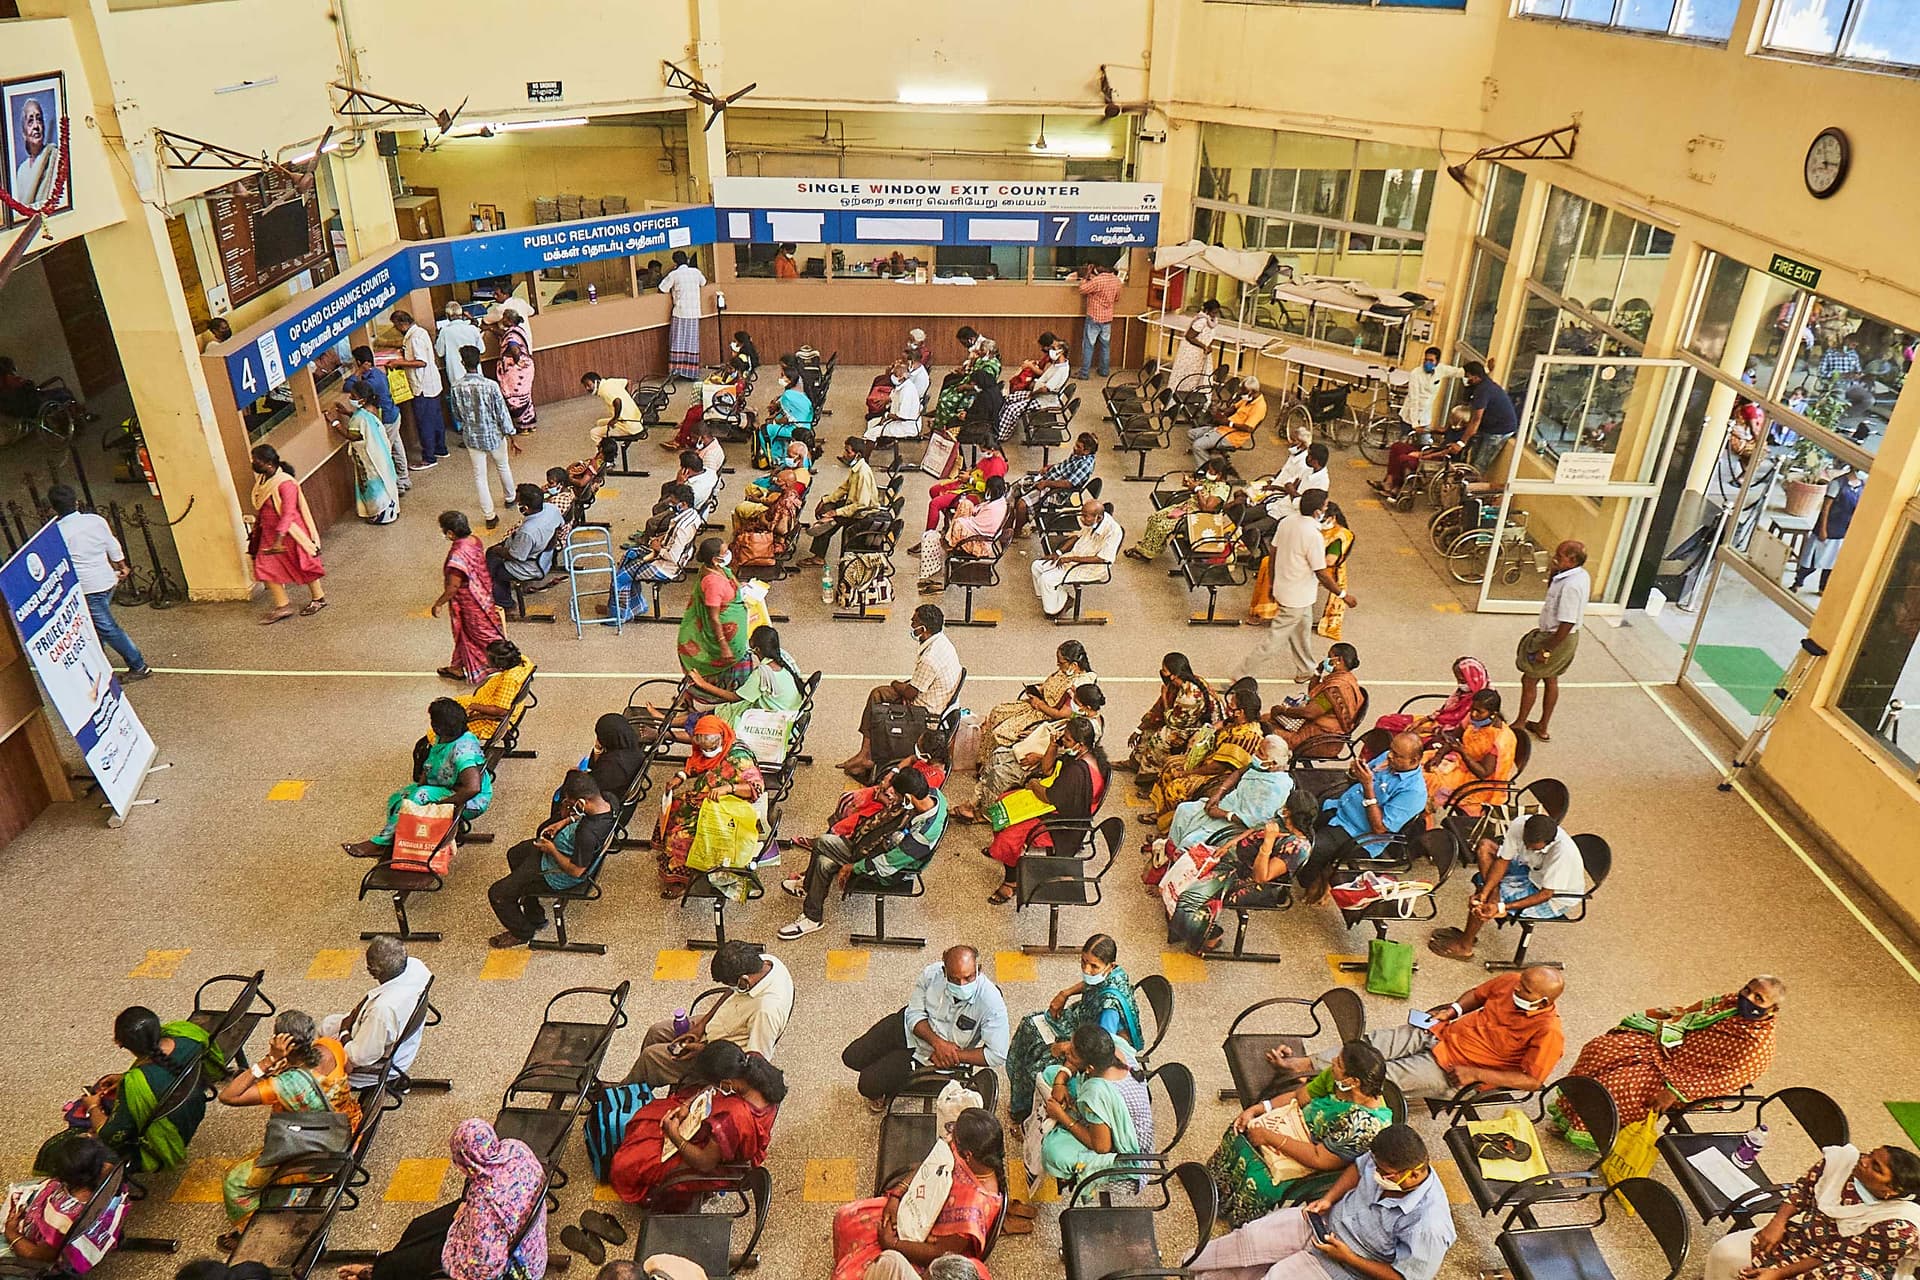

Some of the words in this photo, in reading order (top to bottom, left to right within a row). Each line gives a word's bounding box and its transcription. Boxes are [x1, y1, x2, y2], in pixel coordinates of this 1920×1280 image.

[797, 183, 860, 194] SINGLE
[870, 184, 941, 195] WINDOW
[951, 186, 990, 196] EXIT
[998, 186, 1080, 196] COUNTER
[840, 195, 884, 207] ஒற்றை
[888, 198, 922, 207] சாளர
[926, 196, 998, 208] வெளியேறு
[1002, 196, 1047, 206] மையம்
[1052, 216, 1070, 242] 7
[1088, 214, 1110, 222] CASH
[1112, 214, 1150, 222] COUNTER
[523, 232, 567, 248] PUBLIC
[570, 222, 631, 242] RELATIONS
[632, 216, 679, 232] OFFICER
[543, 245, 580, 262] மக்கள்
[582, 239, 624, 258] தொடர்பு
[626, 232, 666, 250] அதிகாரி
[418, 251, 440, 282] 5
[1774, 258, 1795, 276] FIRE
[1794, 266, 1816, 283] EXIT
[289, 324, 301, 341] OP
[302, 311, 323, 333] CARD
[322, 286, 362, 320] CLEARANCE
[360, 268, 390, 295] COUNTER
[242, 357, 256, 394] 4
[744, 725, 783, 737] MUKUNDA
